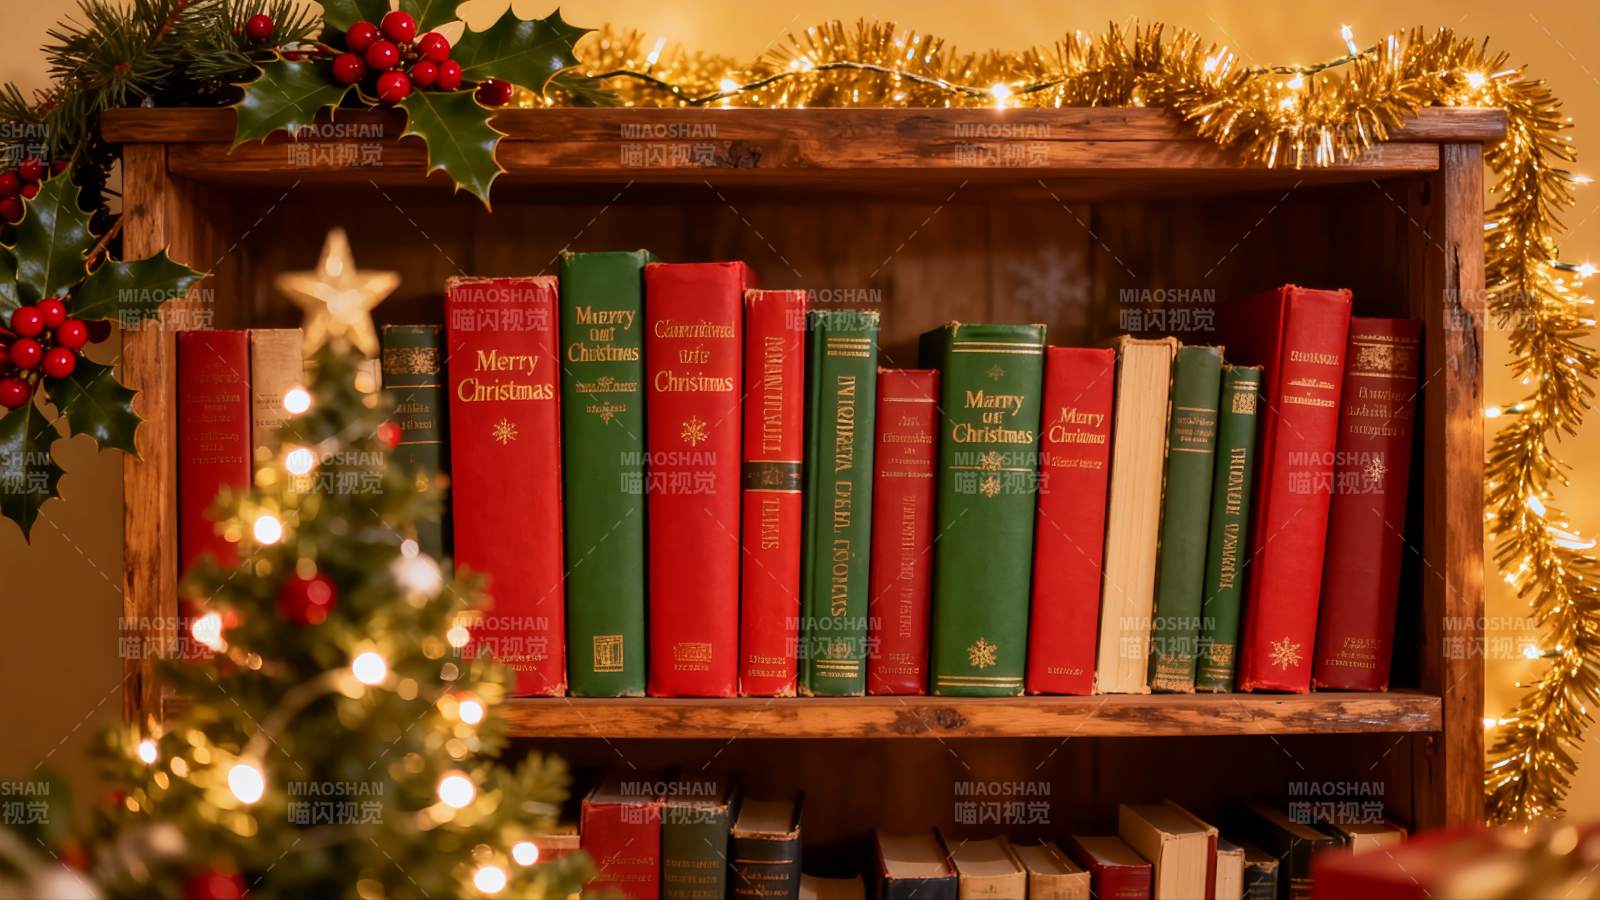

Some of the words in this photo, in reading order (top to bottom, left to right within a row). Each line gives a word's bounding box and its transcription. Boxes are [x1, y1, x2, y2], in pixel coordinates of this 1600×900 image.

[474, 350, 539, 376] Merry
[457, 378, 554, 402] Christmas
[952, 423, 1033, 444] Christmas
